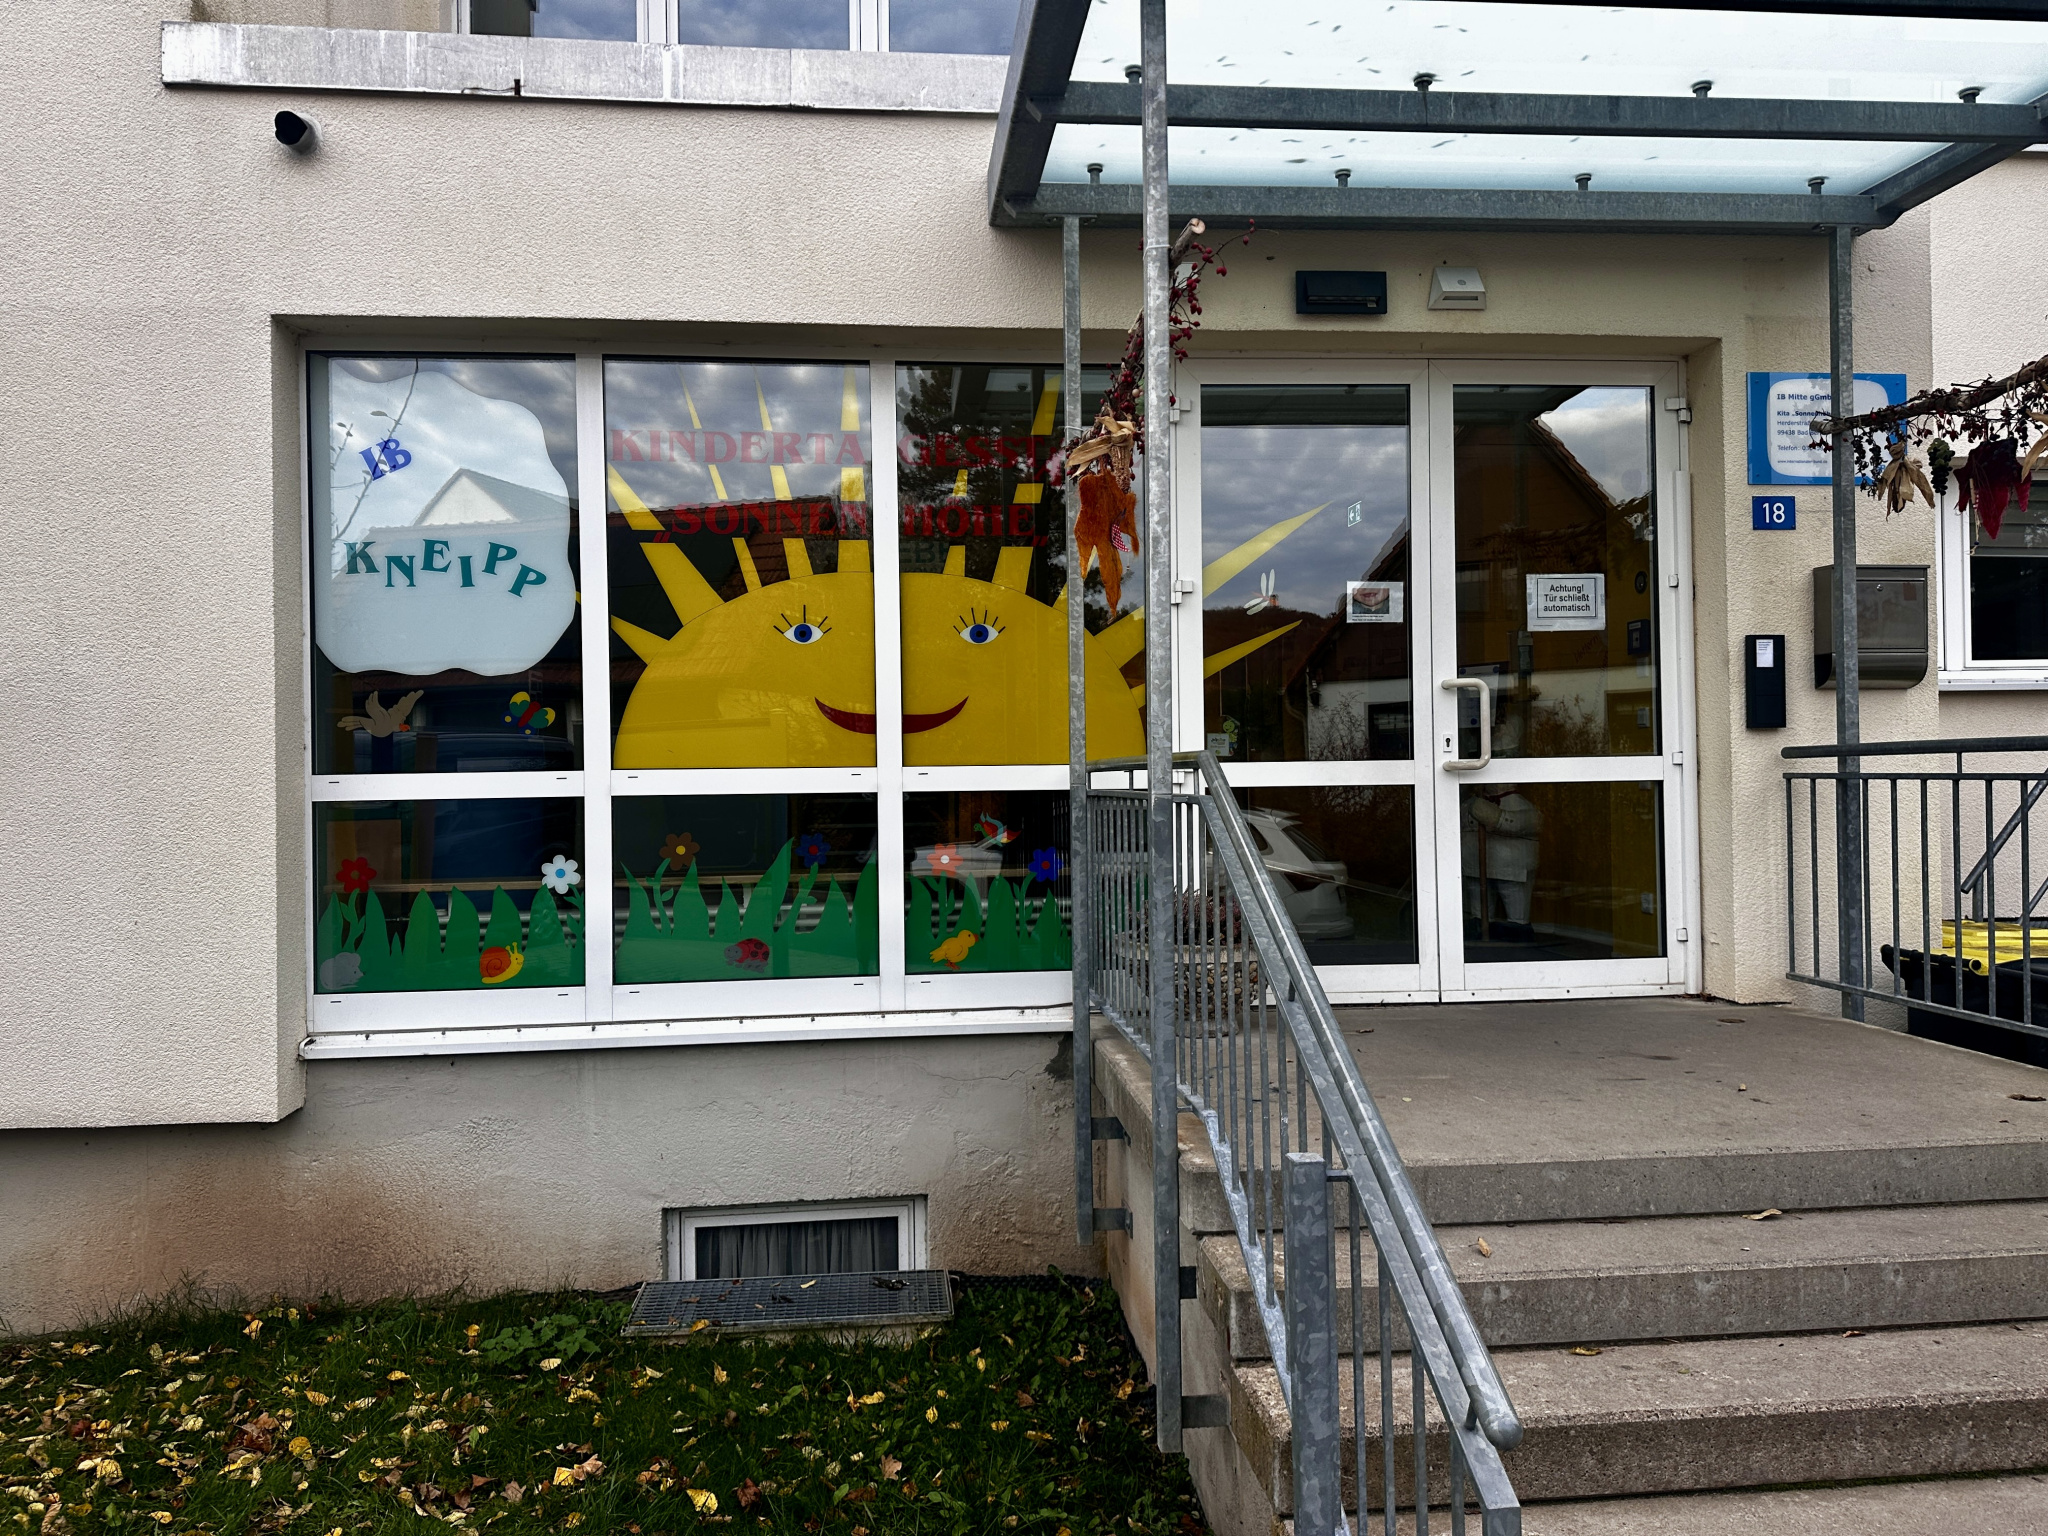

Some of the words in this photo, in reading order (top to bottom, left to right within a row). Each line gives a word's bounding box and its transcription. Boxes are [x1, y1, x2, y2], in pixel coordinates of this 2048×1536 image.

[1809, 393, 1832, 402] gGmb
[358, 438, 412, 482] IB
[1762, 502, 1785, 524] 18
[343, 538, 548, 598] KNEIPP
[1549, 584, 1584, 594] Achtung!
[1559, 594, 1590, 602] schließt
